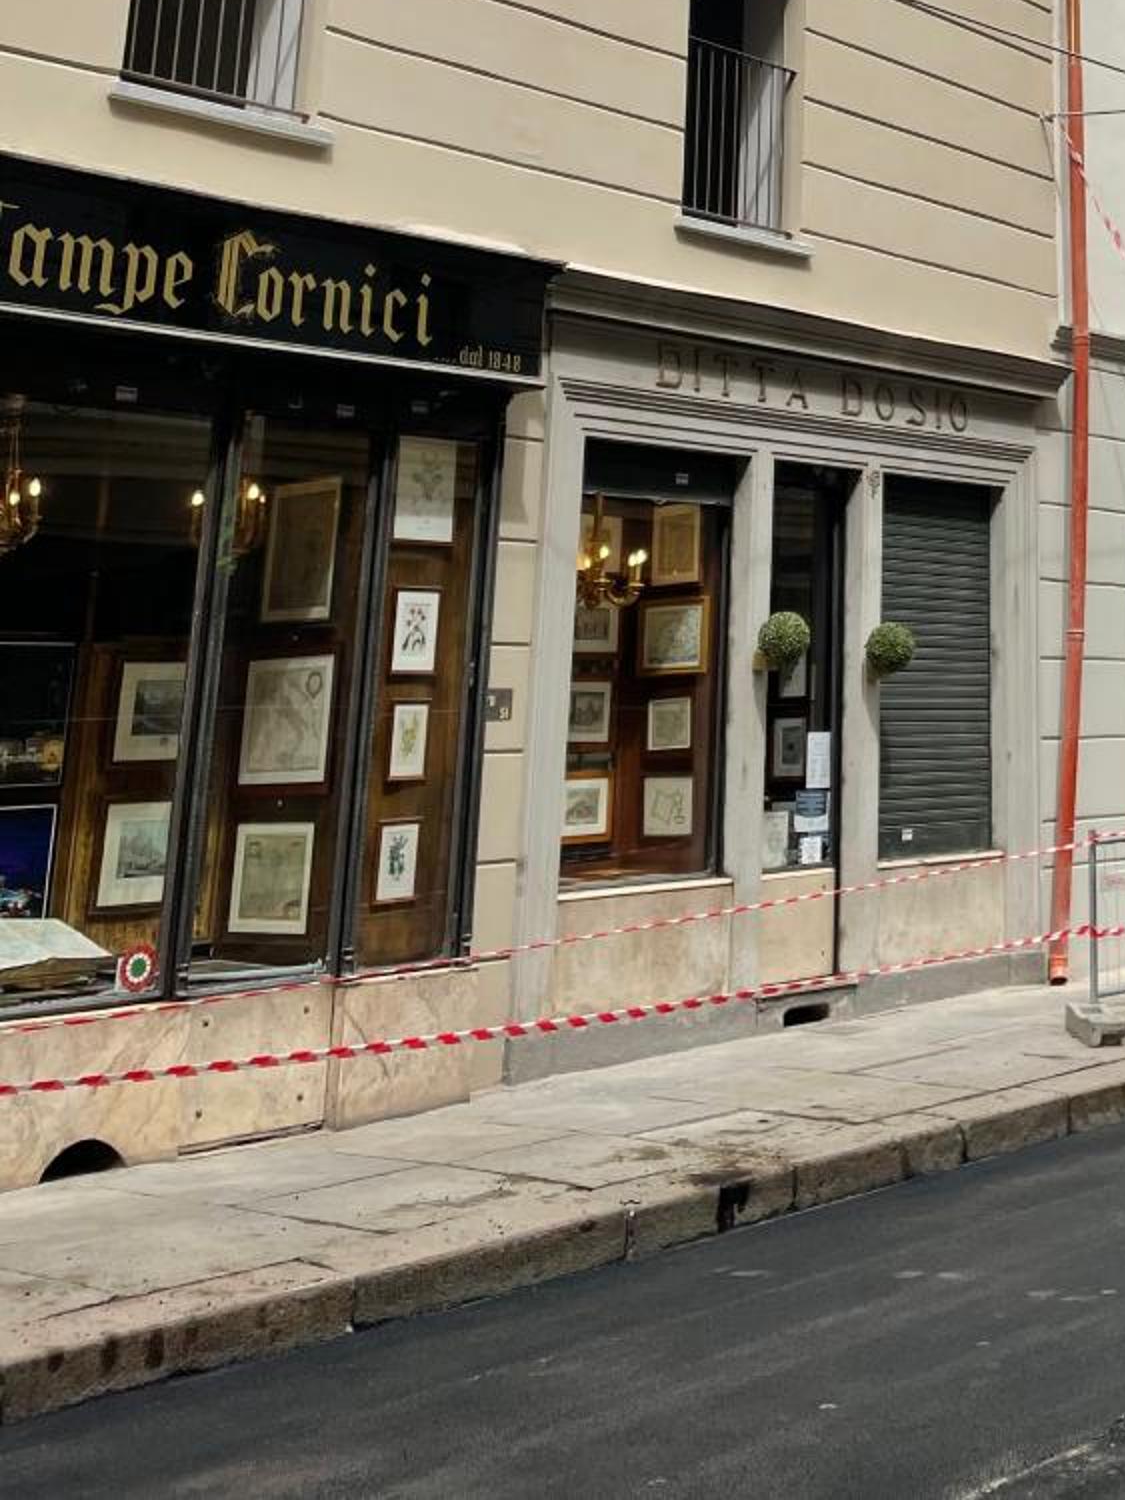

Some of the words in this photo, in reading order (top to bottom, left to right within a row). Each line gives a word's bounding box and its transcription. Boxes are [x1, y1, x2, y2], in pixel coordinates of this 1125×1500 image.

[0, 202, 193, 315] ampe
[213, 229, 433, 346] Cornici
[489, 350, 521, 373] 1848
[656, 342, 809, 410] DITTA
[840, 372, 968, 433] DOSIO
